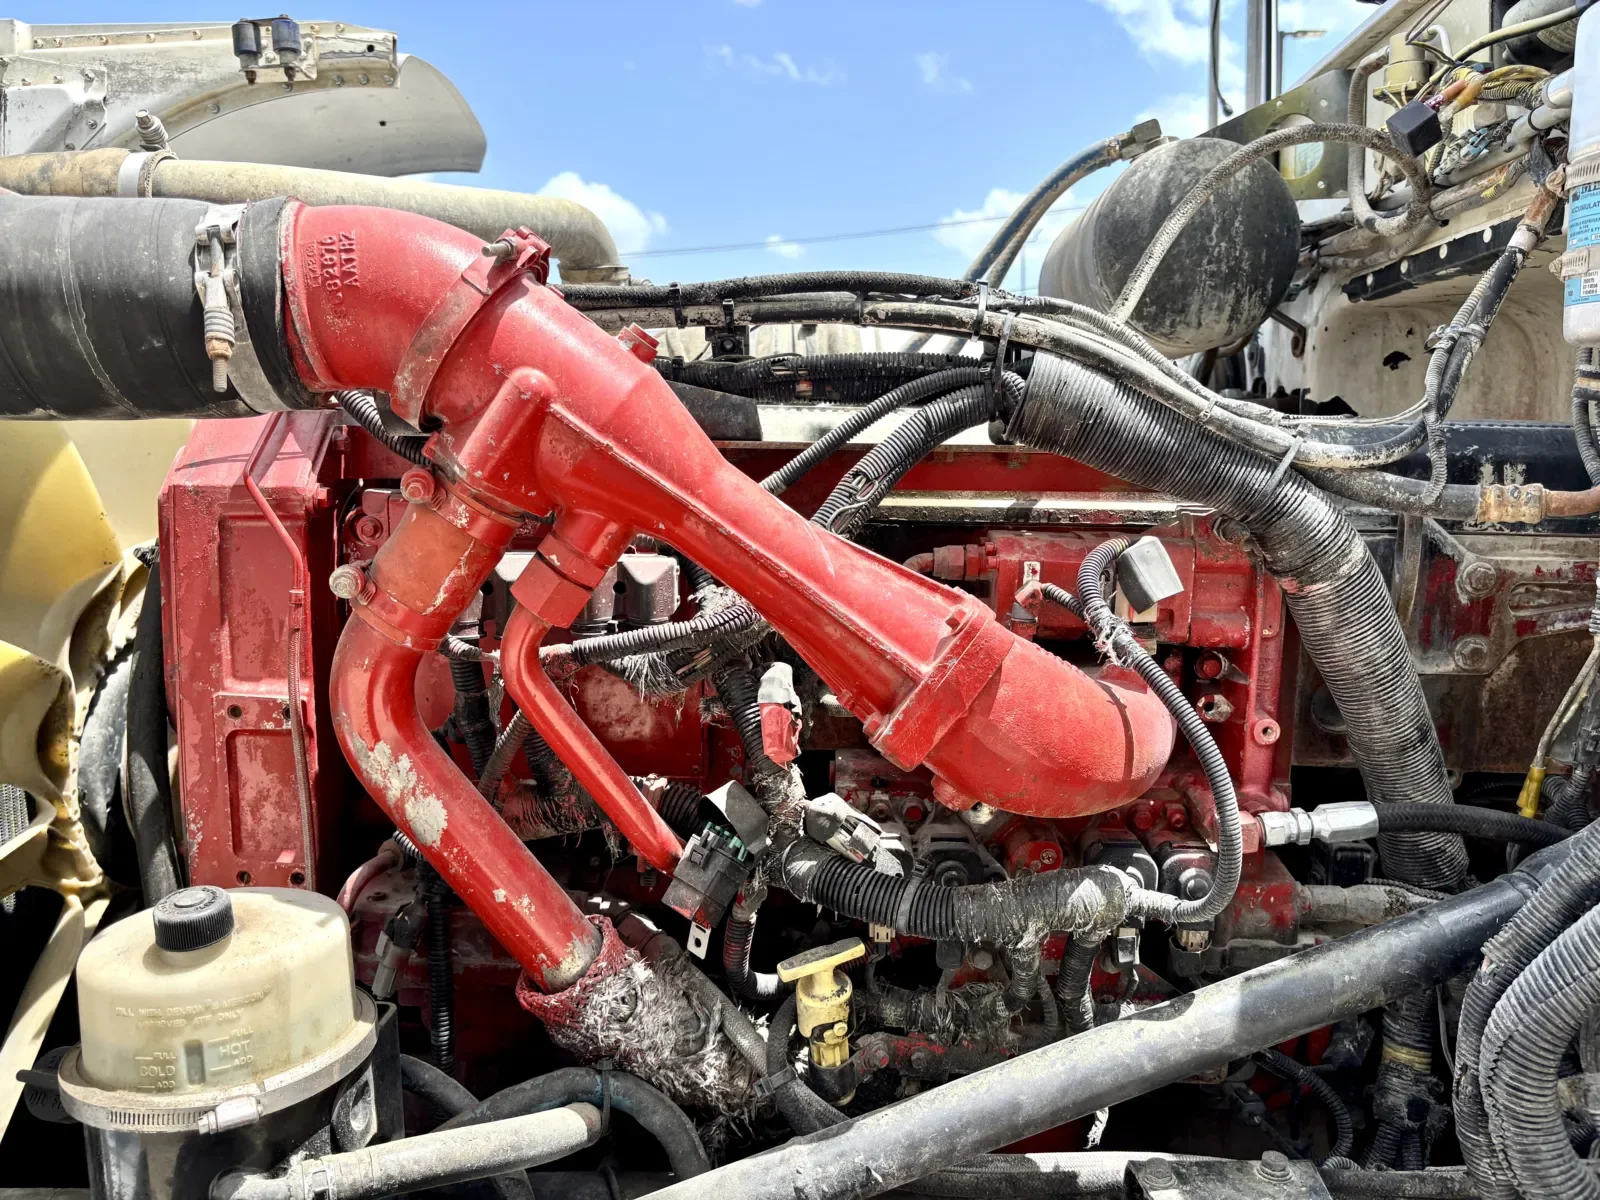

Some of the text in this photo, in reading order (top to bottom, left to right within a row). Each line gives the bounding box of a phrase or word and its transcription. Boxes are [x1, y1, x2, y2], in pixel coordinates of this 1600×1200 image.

[138, 1008, 162, 1018] WITH
[192, 1014, 213, 1026] ATF
[218, 1008, 245, 1022] ONLY
[230, 1026, 254, 1038] FULL
[219, 1040, 250, 1057] HOT
[153, 1052, 177, 1060] FULL
[234, 1055, 254, 1067] ADD
[140, 1065, 176, 1077] COLD
[157, 1080, 176, 1089] ADD
